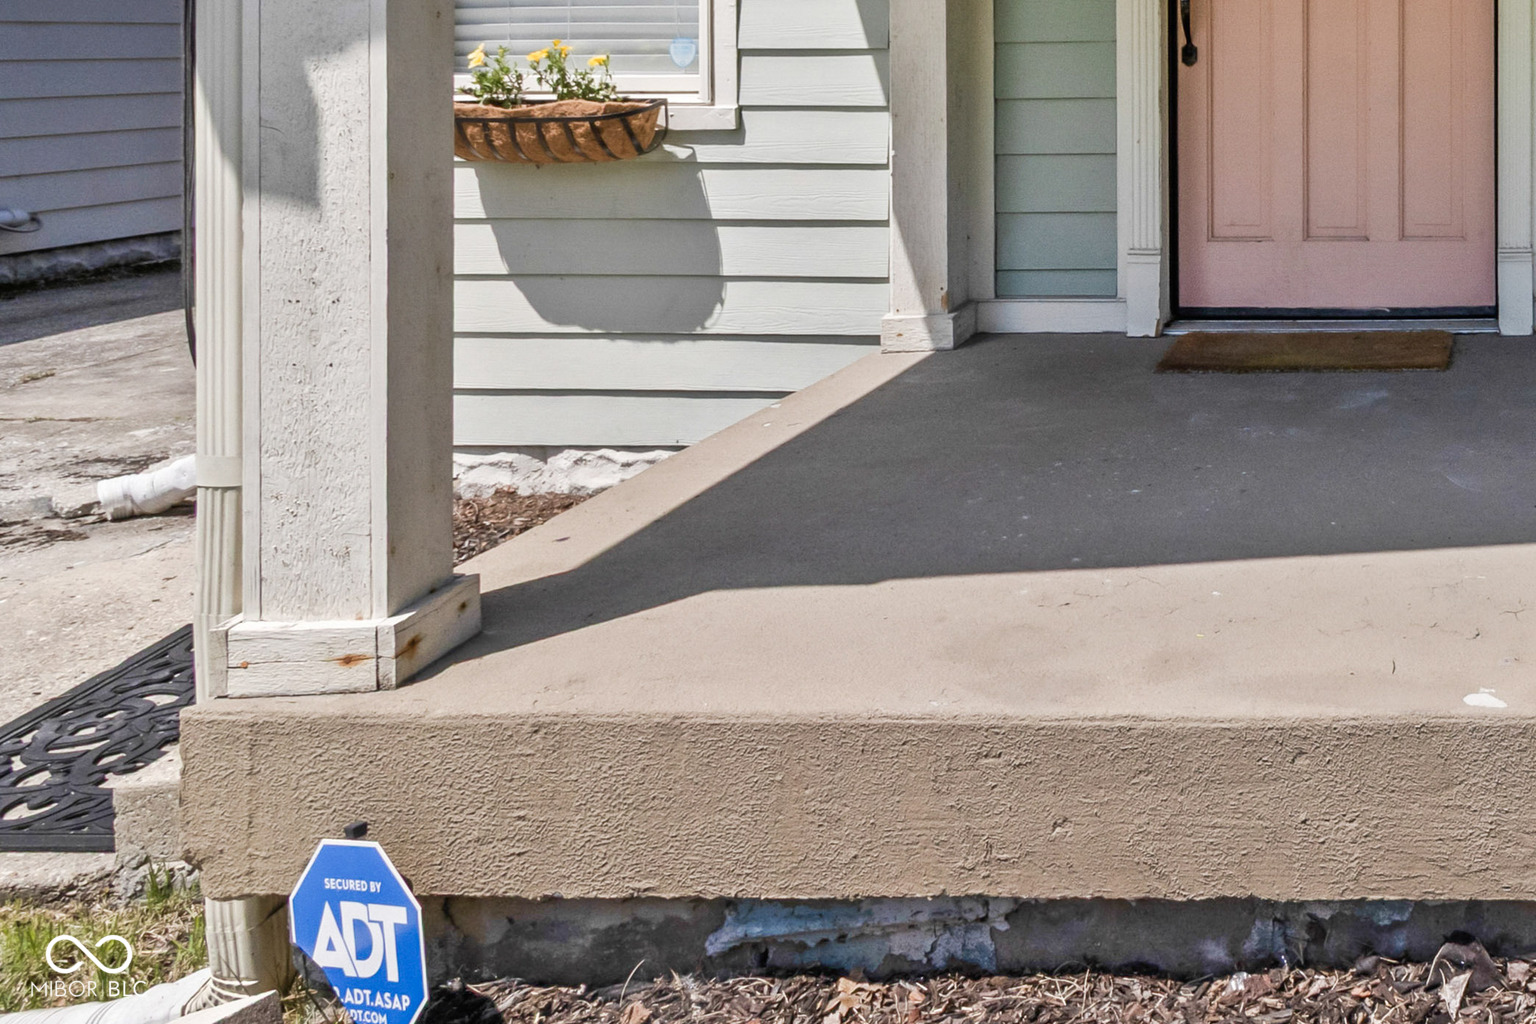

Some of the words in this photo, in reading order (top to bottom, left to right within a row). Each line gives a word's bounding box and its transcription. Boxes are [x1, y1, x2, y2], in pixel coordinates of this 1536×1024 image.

[325, 878, 367, 891] SECURED
[370, 881, 381, 893] BY
[312, 901, 407, 982] ADT
